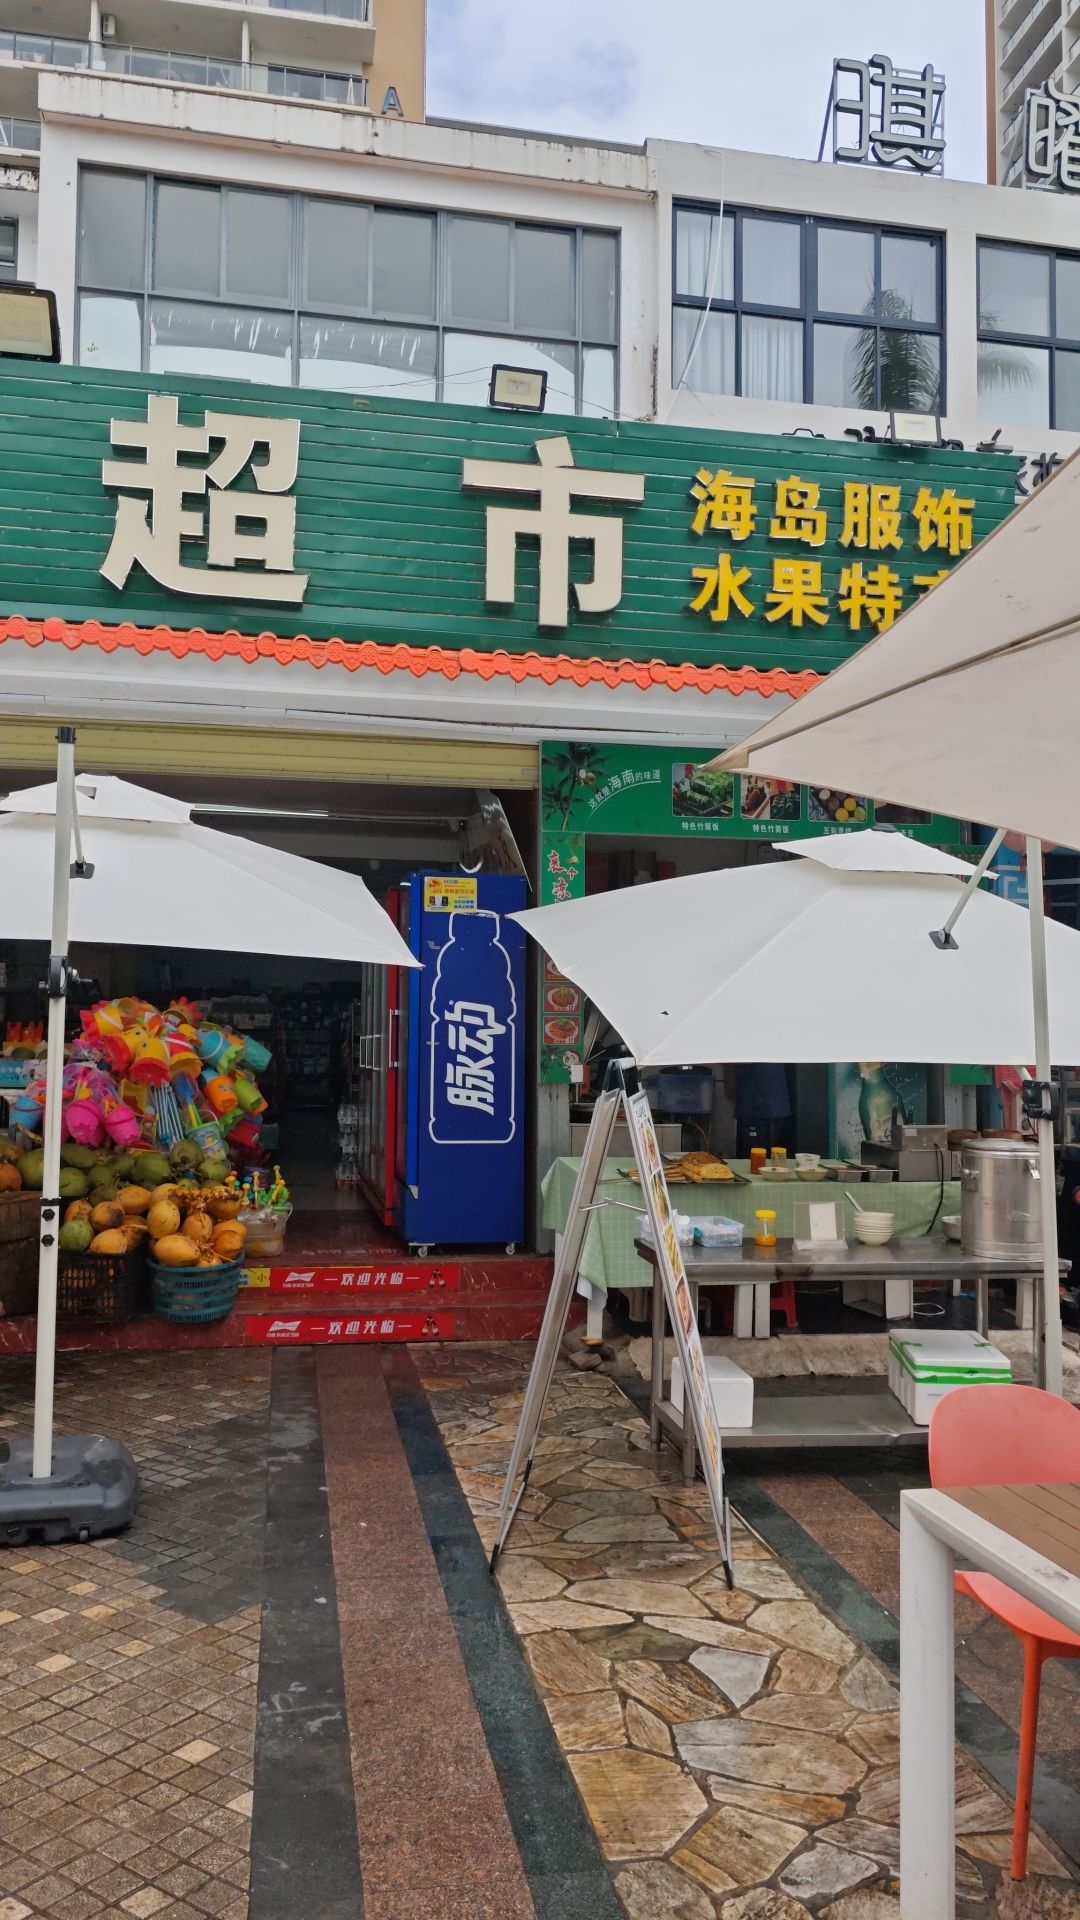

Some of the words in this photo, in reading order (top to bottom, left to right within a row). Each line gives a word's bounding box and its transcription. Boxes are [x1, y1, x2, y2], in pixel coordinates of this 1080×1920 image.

[381, 86, 404, 117] A
[100, 395, 645, 629] 超市
[689, 467, 976, 557] 海岛服饰
[588, 769, 661, 809] 这就是海南的味道
[681, 822, 719, 831] 特色竹筒饭
[752, 824, 790, 834] 特色竹筒饭
[444, 1000, 507, 1116] 脉动
[341, 1271, 404, 1286] 欢迎光临
[328, 1319, 395, 1335] 欢迎光临
